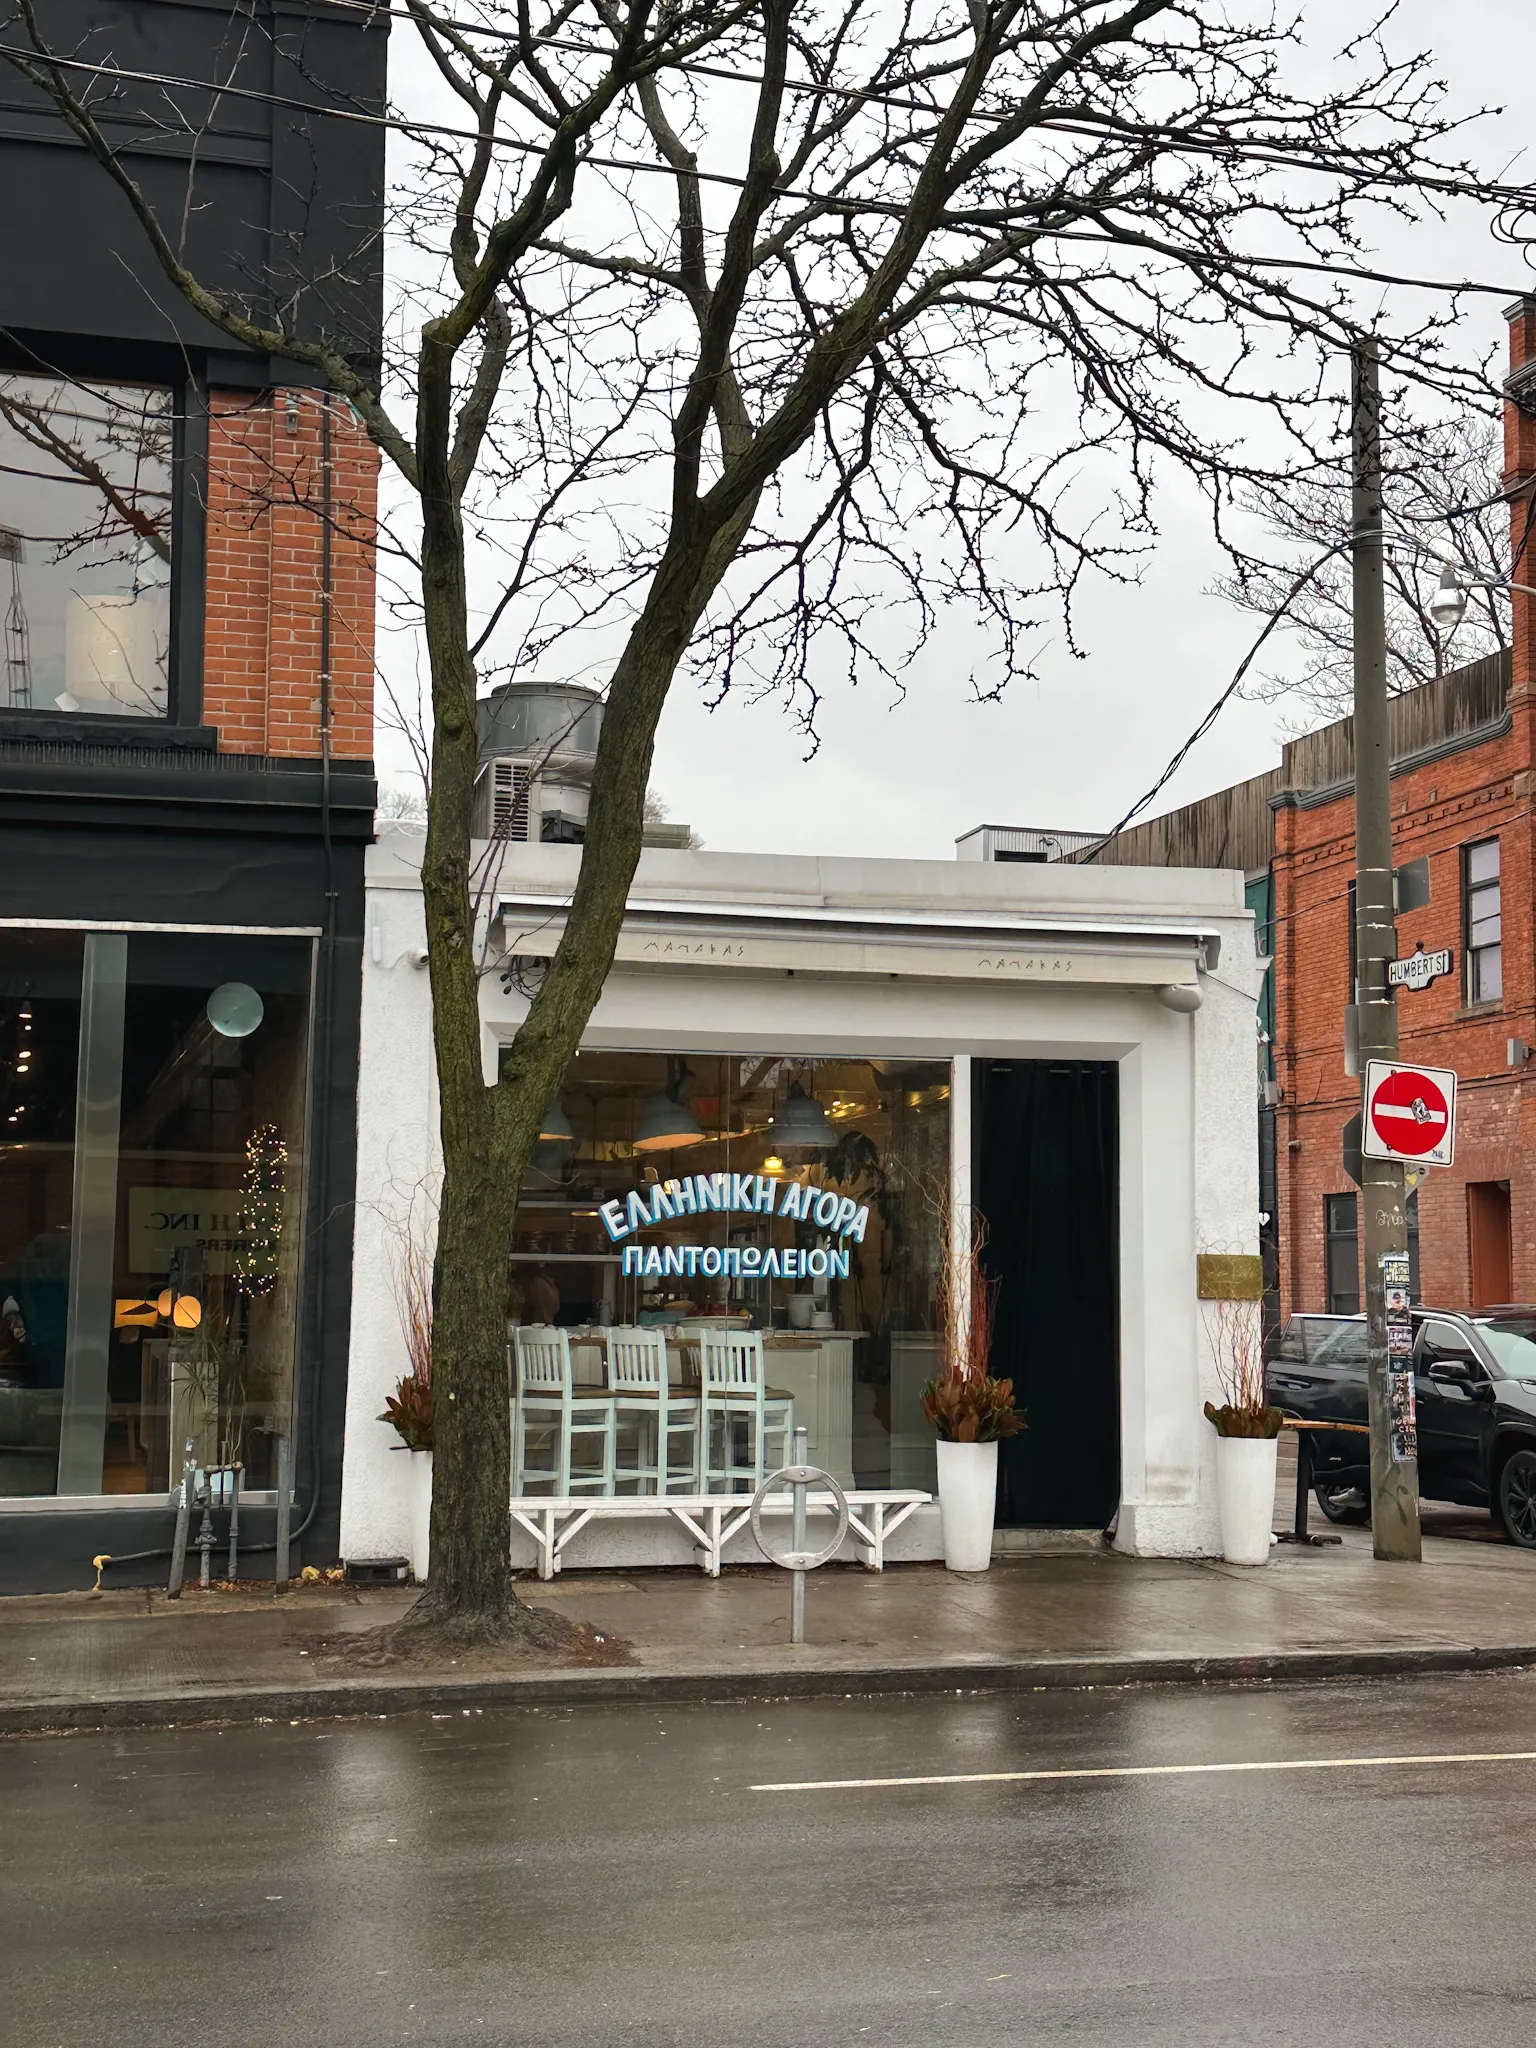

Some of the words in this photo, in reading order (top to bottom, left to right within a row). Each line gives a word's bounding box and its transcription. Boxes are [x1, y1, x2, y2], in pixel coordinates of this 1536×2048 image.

[643, 941, 745, 957] MAMAKAS
[977, 958, 1073, 972] MAMAKAS
[1390, 956, 1434, 981] HUMBERT
[600, 1173, 777, 1242] ΕΛΛΗΝΙΚΗ
[778, 1182, 869, 1243] ΑΓΟΡΑ
[622, 1245, 850, 1279] ΠΑΝΤΟΠΩΛΕΙΟΝ
